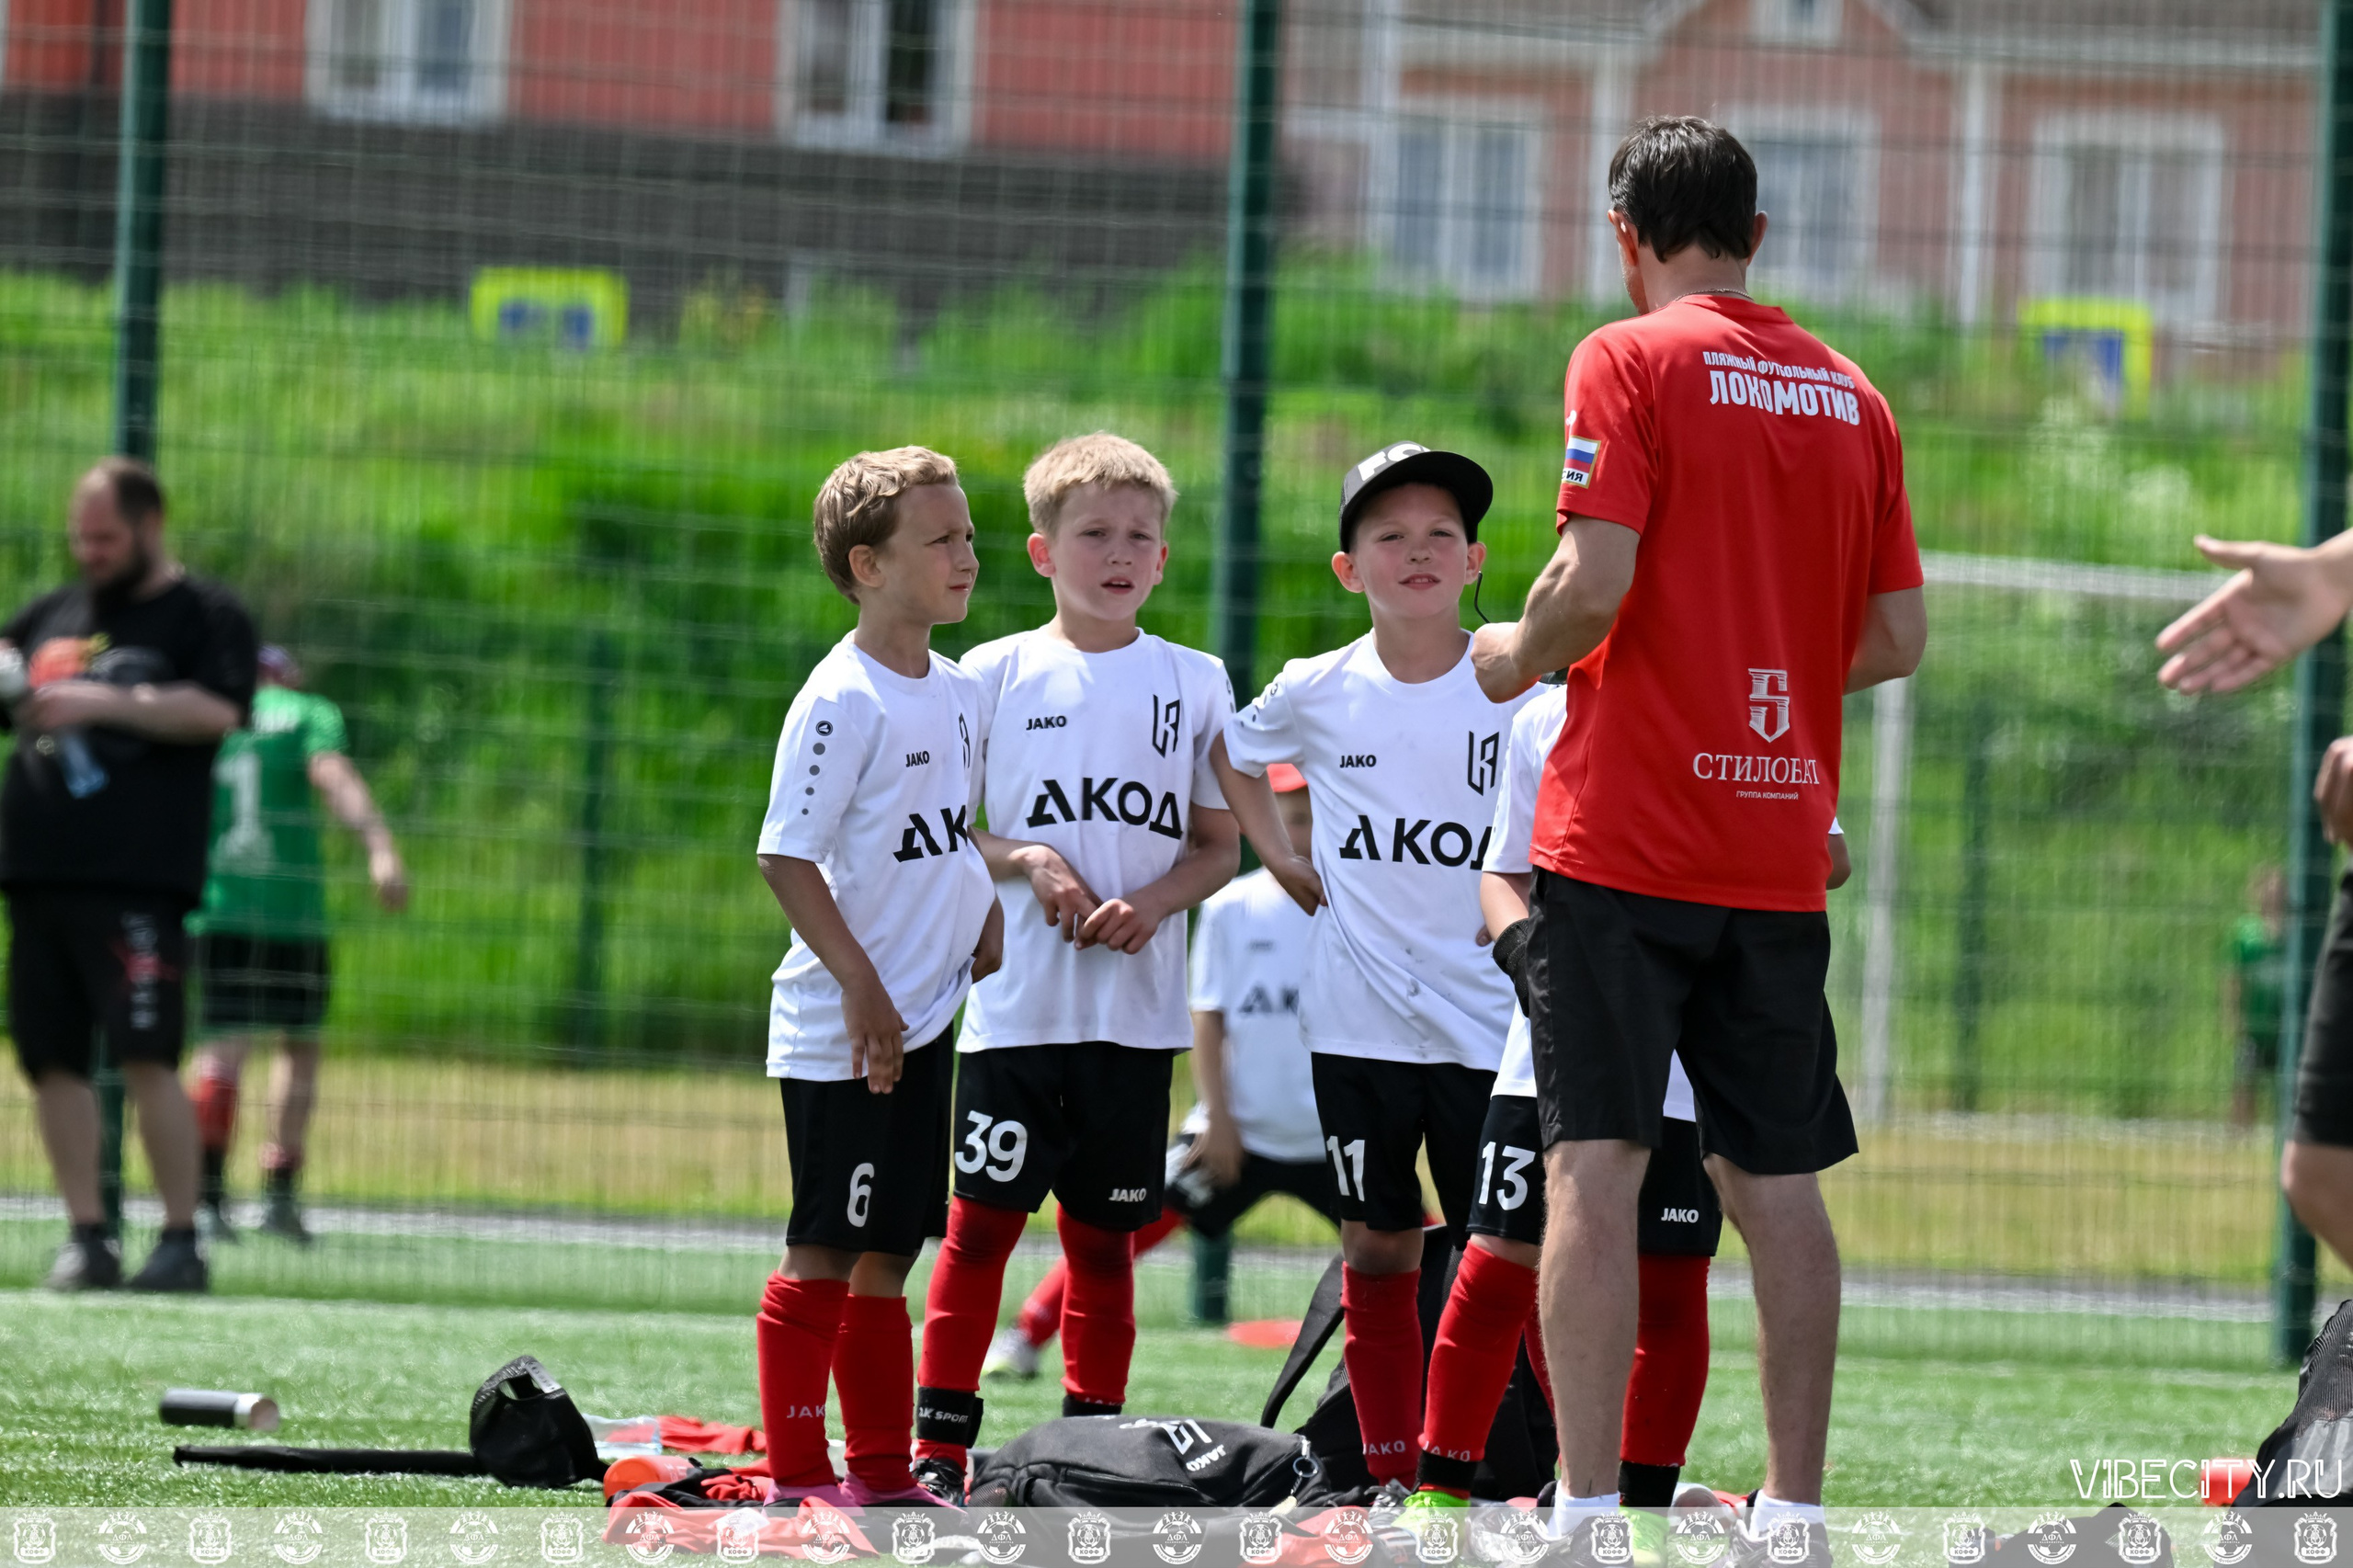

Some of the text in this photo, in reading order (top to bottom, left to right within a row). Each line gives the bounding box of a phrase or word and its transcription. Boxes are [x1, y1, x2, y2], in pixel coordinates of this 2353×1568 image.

[1702, 351, 1856, 390] ПЛЯЖНЫЙ ФУТБОЛЬНЫЙ КЛУБ
[1710, 369, 1860, 426] ЛОКОМОТИВ
[1025, 714, 1067, 731] JAKO
[905, 750, 930, 768] JAKO
[1339, 754, 1377, 768] JAKO
[1692, 752, 1820, 785] СТИЛОБАТ
[1735, 790, 1799, 801] ГРУППА КОМПАНИЙ
[954, 1109, 1029, 1183] 39
[1326, 1135, 1366, 1202] 11
[1478, 1141, 1536, 1211] 13
[847, 1162, 875, 1228] 6
[1108, 1187, 1147, 1203] JAKO
[1660, 1207, 1699, 1224] JAKO
[786, 1403, 826, 1419] JAK
[1185, 1444, 1227, 1472] JAKO
